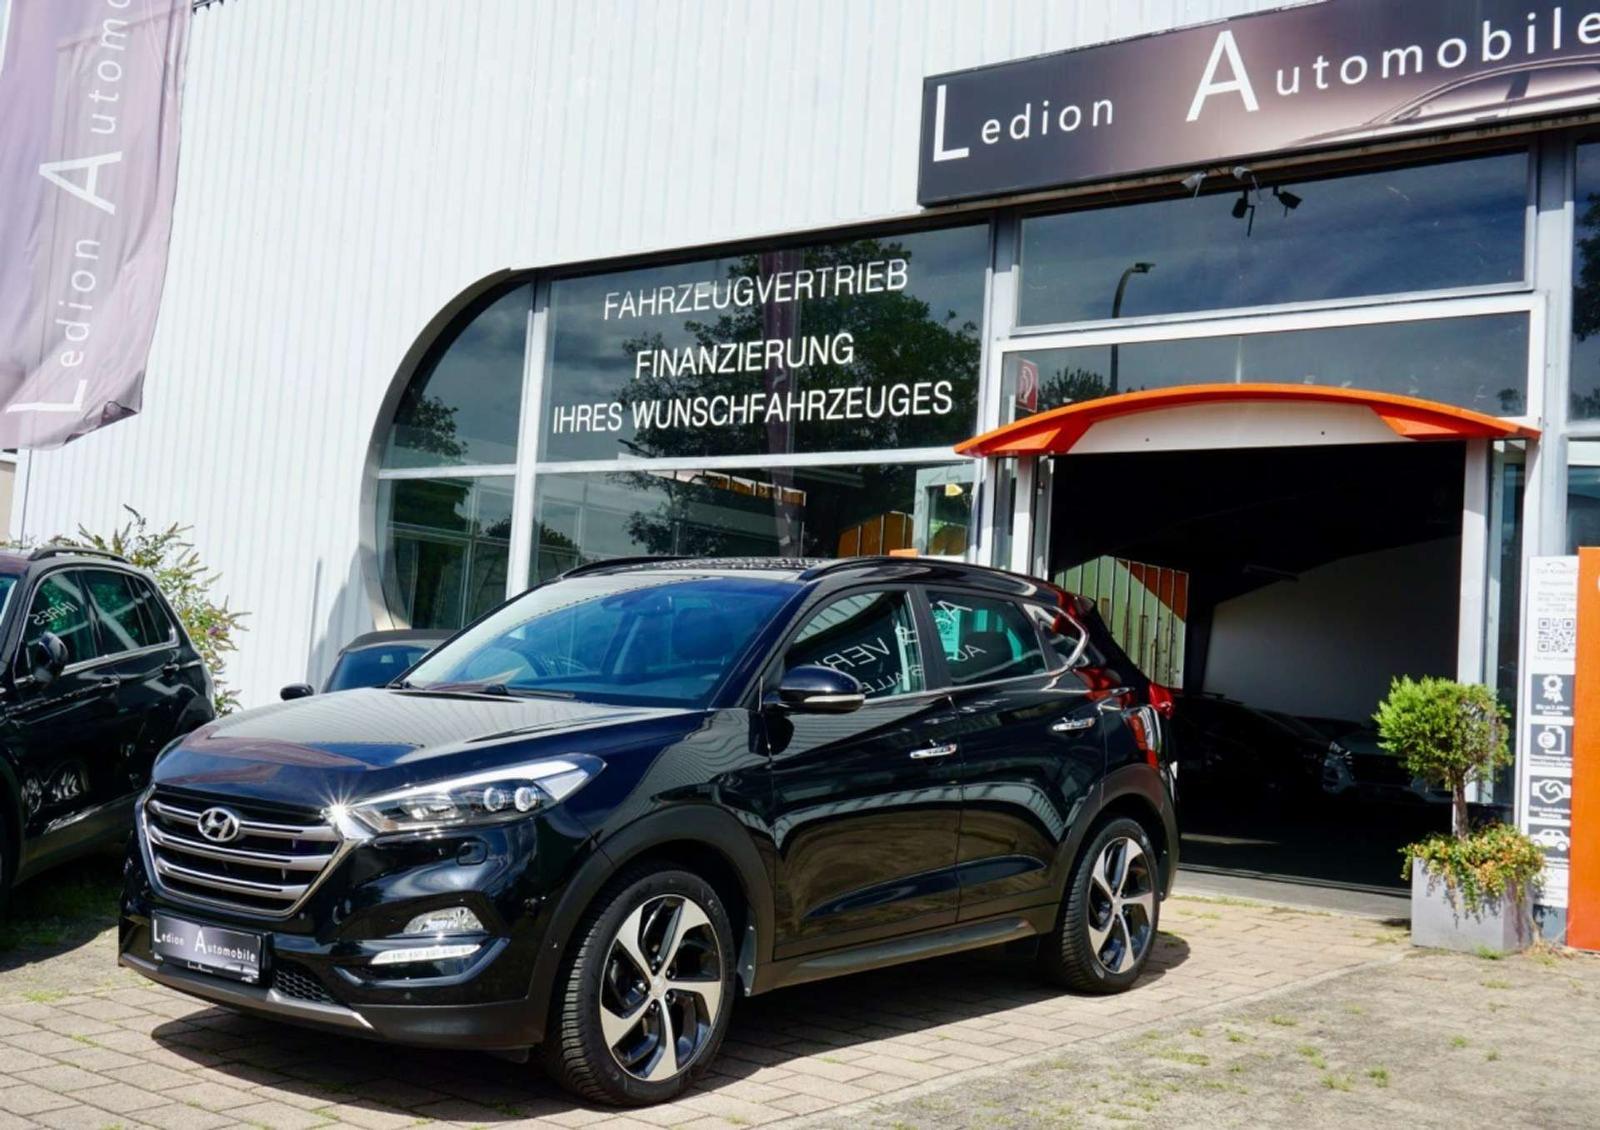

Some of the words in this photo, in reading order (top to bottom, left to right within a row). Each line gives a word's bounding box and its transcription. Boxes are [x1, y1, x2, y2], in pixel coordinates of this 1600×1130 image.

[932, 84, 1114, 163] Ledion
[1185, 6, 1600, 122] Automobile
[604, 258, 909, 320] FAHRZEUGVERTRIEB
[6, 239, 100, 413] Ledion
[635, 332, 855, 379] FINANZIERUNG
[553, 403, 623, 434] IHRES
[632, 380, 953, 430] WUNSCHFAHRZEUGES
[153, 919, 185, 946] Ledion
[194, 929, 256, 963] Automobile
